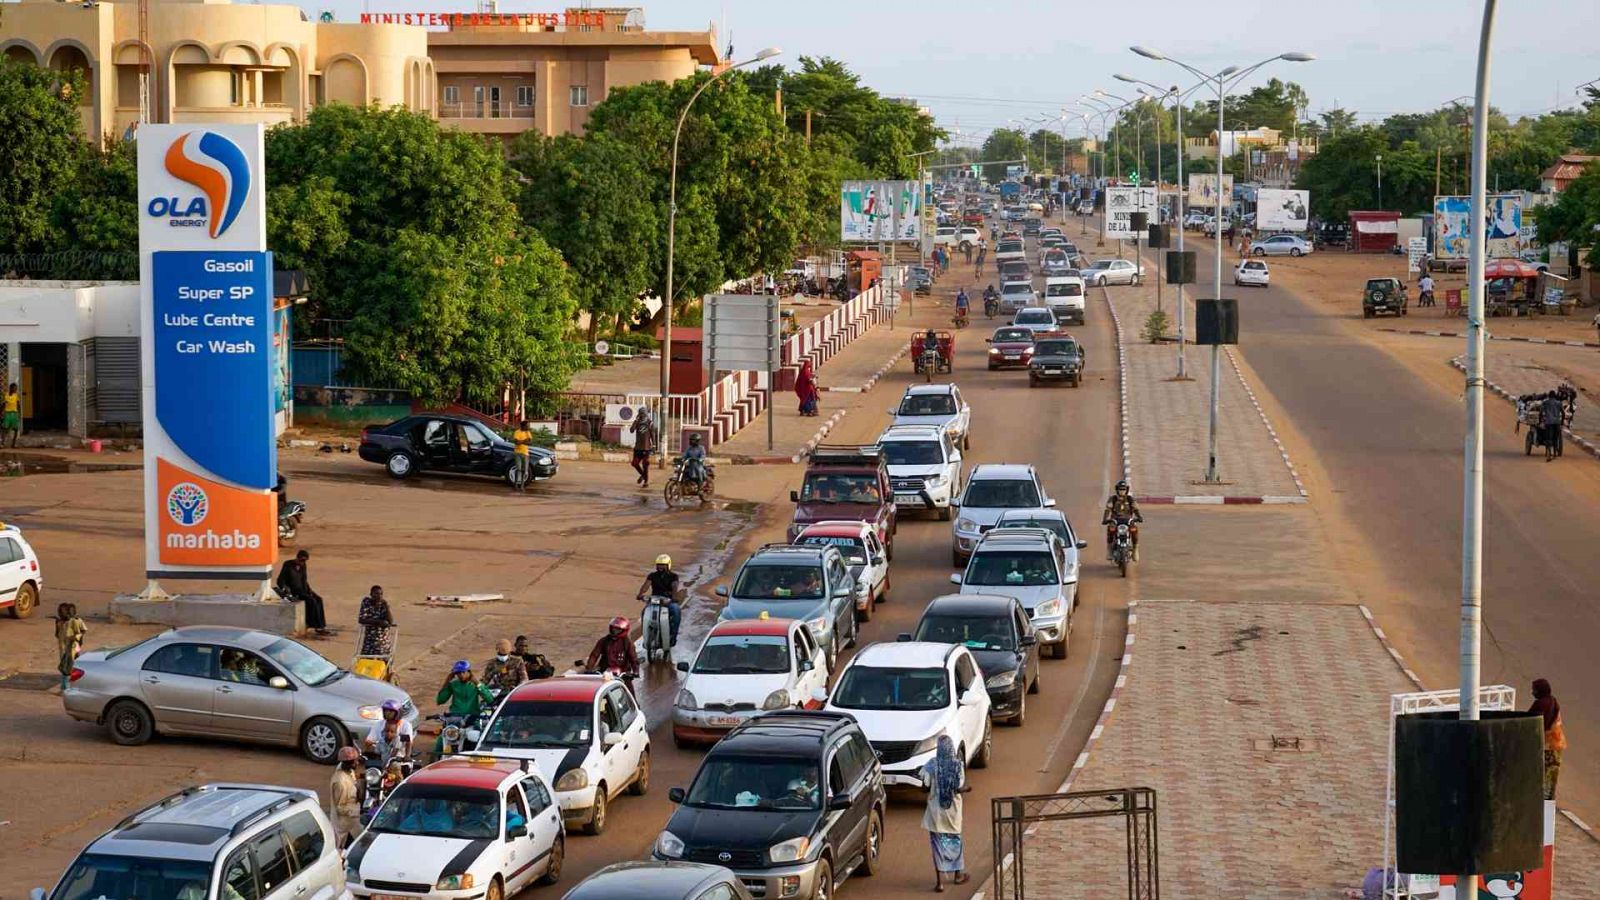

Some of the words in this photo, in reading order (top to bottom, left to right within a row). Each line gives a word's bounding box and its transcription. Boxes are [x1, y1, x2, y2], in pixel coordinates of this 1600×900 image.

[360, 13, 463, 26] MINISTERE
[471, 13, 491, 26] DE
[499, 13, 520, 26] LA
[526, 10, 604, 26] JUSTICE
[148, 197, 207, 218] OLA
[170, 219, 207, 227] ENERGY
[203, 259, 254, 273] Gasoil
[178, 286, 224, 302] Super
[229, 286, 254, 299] SP
[164, 313, 199, 327] Lube
[203, 313, 255, 327] Centre
[176, 340, 203, 354] Car
[208, 340, 256, 354] Wash
[166, 529, 260, 549] marhaba
